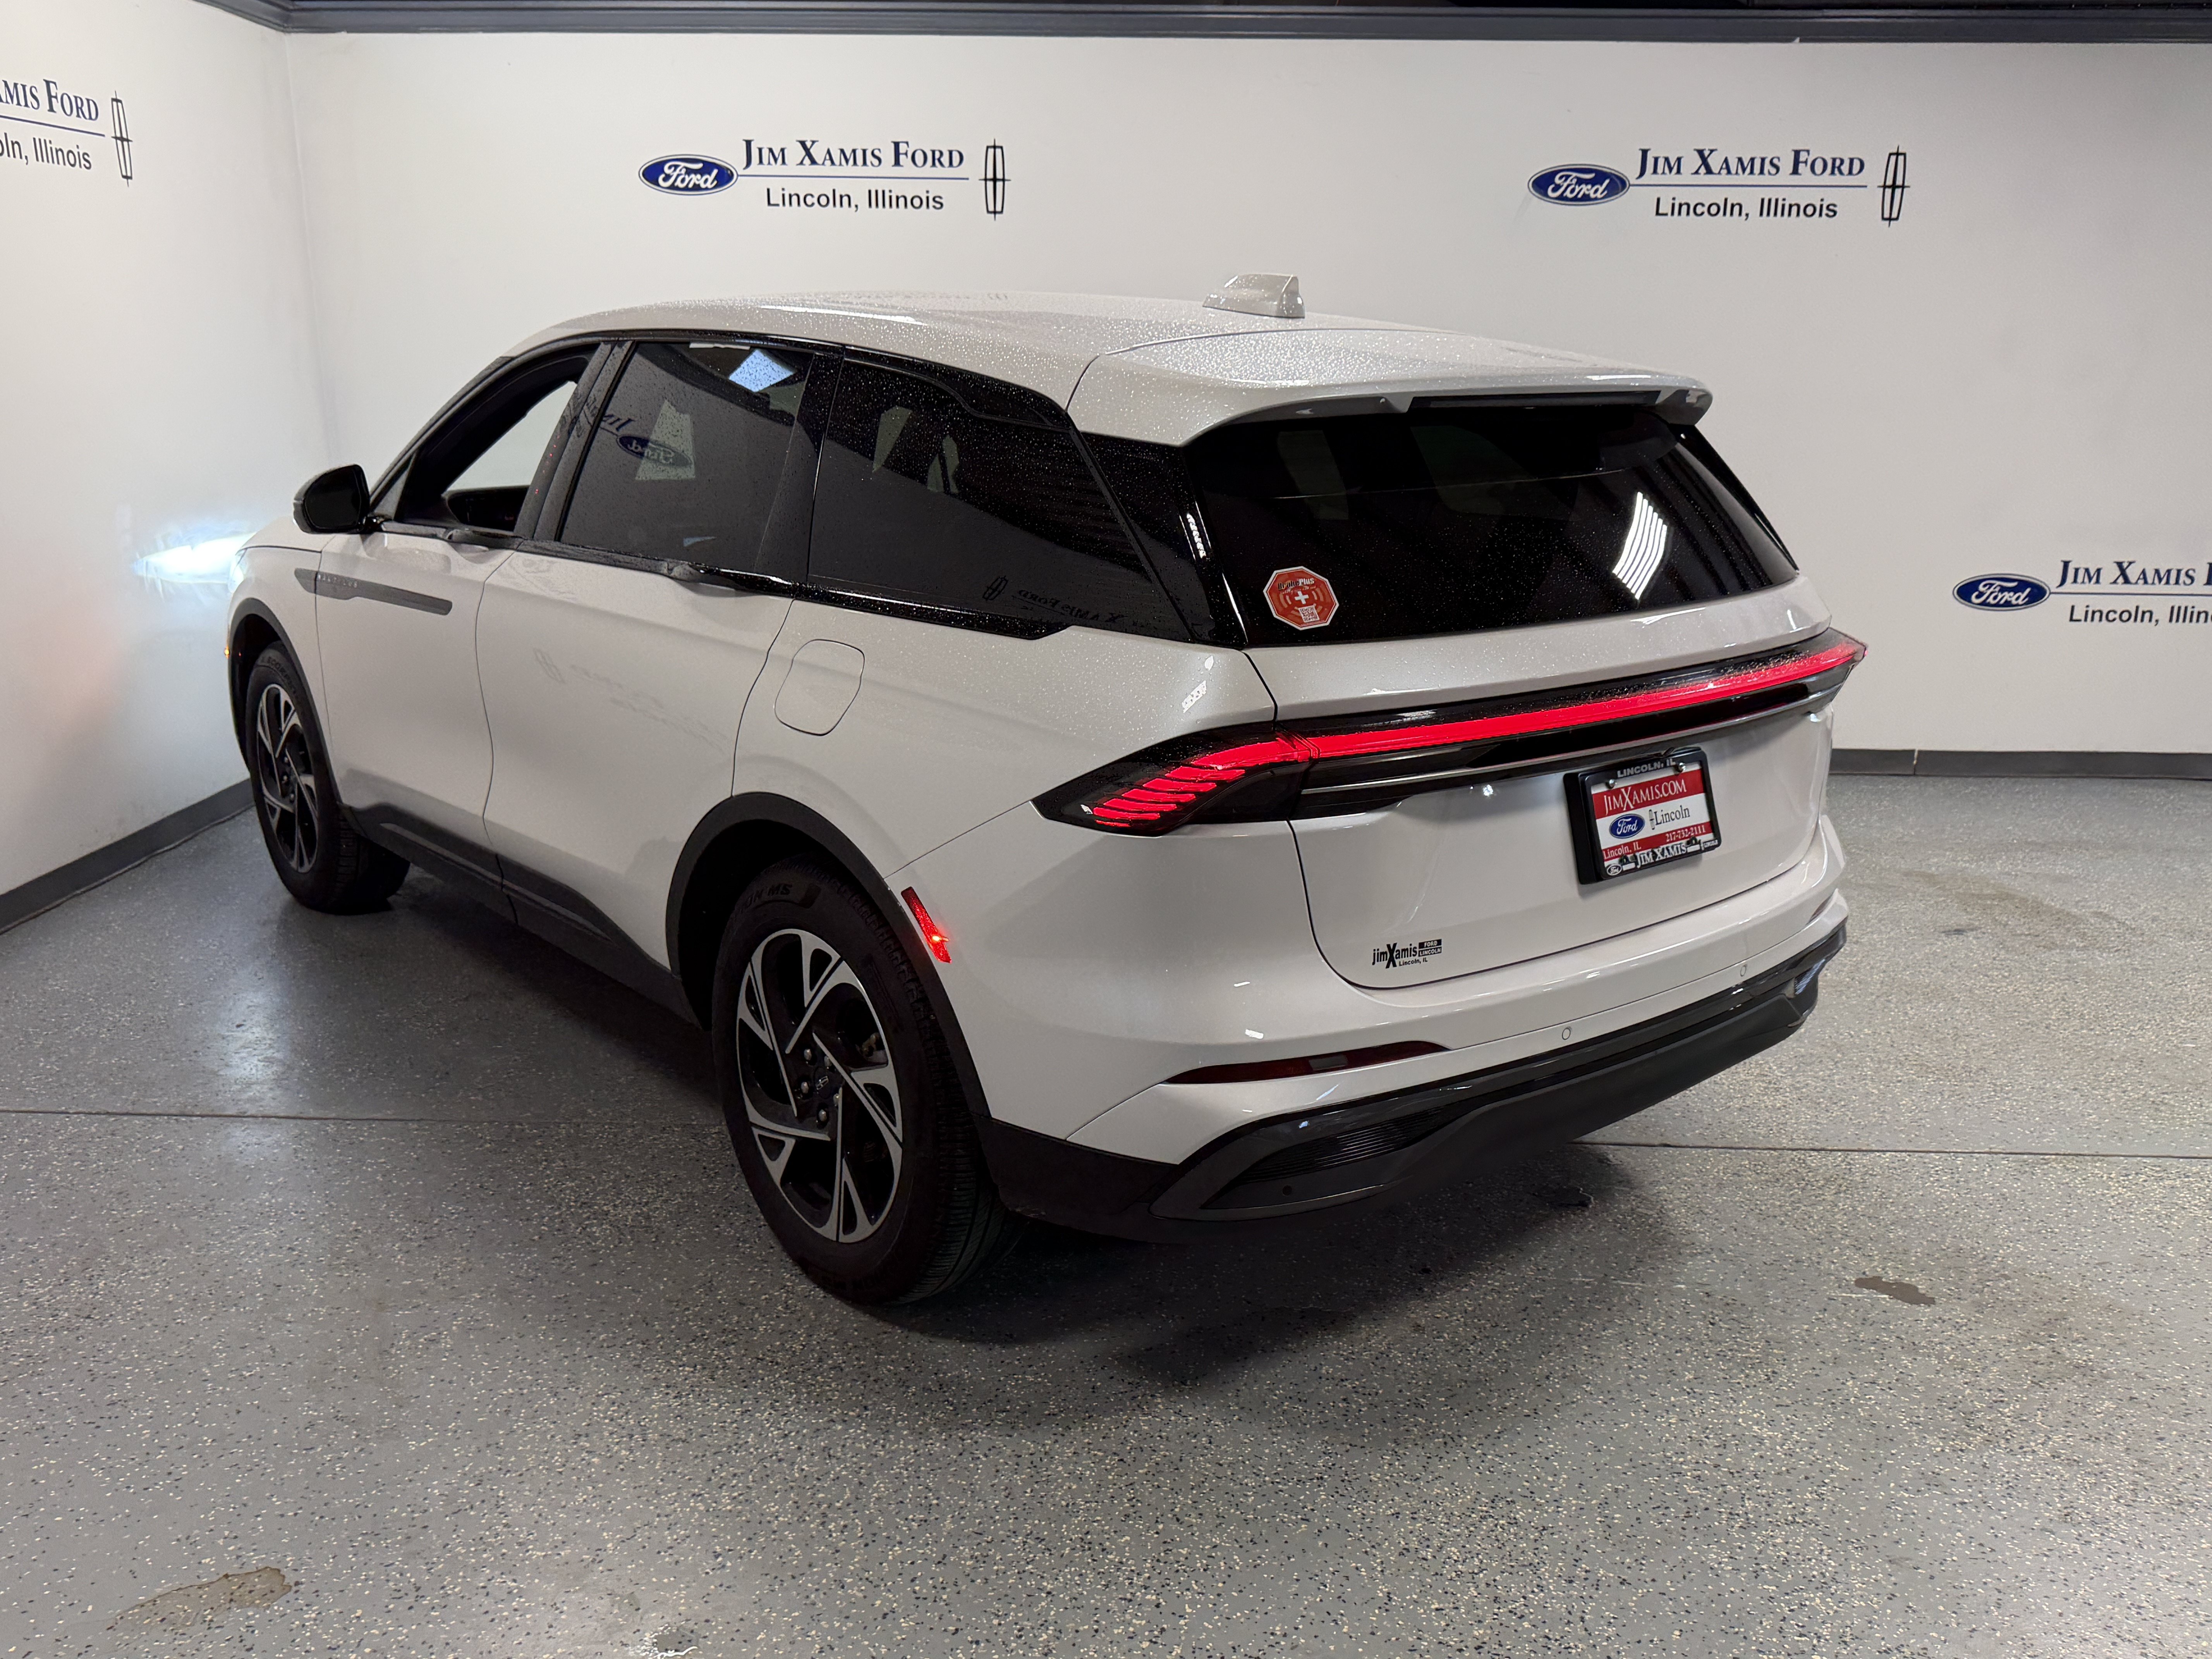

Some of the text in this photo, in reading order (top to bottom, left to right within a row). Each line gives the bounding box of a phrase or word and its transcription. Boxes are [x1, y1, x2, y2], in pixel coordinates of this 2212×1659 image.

[0, 79, 98, 121] MIS FORD
[33, 137, 92, 170] Illinois
[743, 139, 964, 170] JIM XAMIS FORD
[1635, 148, 1865, 180] JIM XAMIS FORD
[658, 161, 718, 189] Ford
[1547, 171, 1610, 199] Ford
[767, 187, 943, 212] Lincoln, Illinois
[1655, 197, 1838, 221] Lincoln, Illinois
[2056, 560, 2102, 588] JIM
[2109, 561, 2196, 586] XAMIS
[1971, 580, 2031, 606] Ford
[2069, 605, 2212, 626] Lincoln, Illin
[1604, 779, 1687, 816] JIMXAMIS.COM
[1616, 805, 1690, 835] Ford Lincoln
[1666, 825, 1706, 842] 217-732-2111
[1633, 842, 1642, 850] IL
[1636, 853, 1654, 868] JIM
[1654, 843, 1687, 861] XAMIS
[1372, 942, 1418, 969] jimXamis
[1399, 958, 1422, 967] Lincoln,
[1419, 947, 1441, 956] LINCOLN
